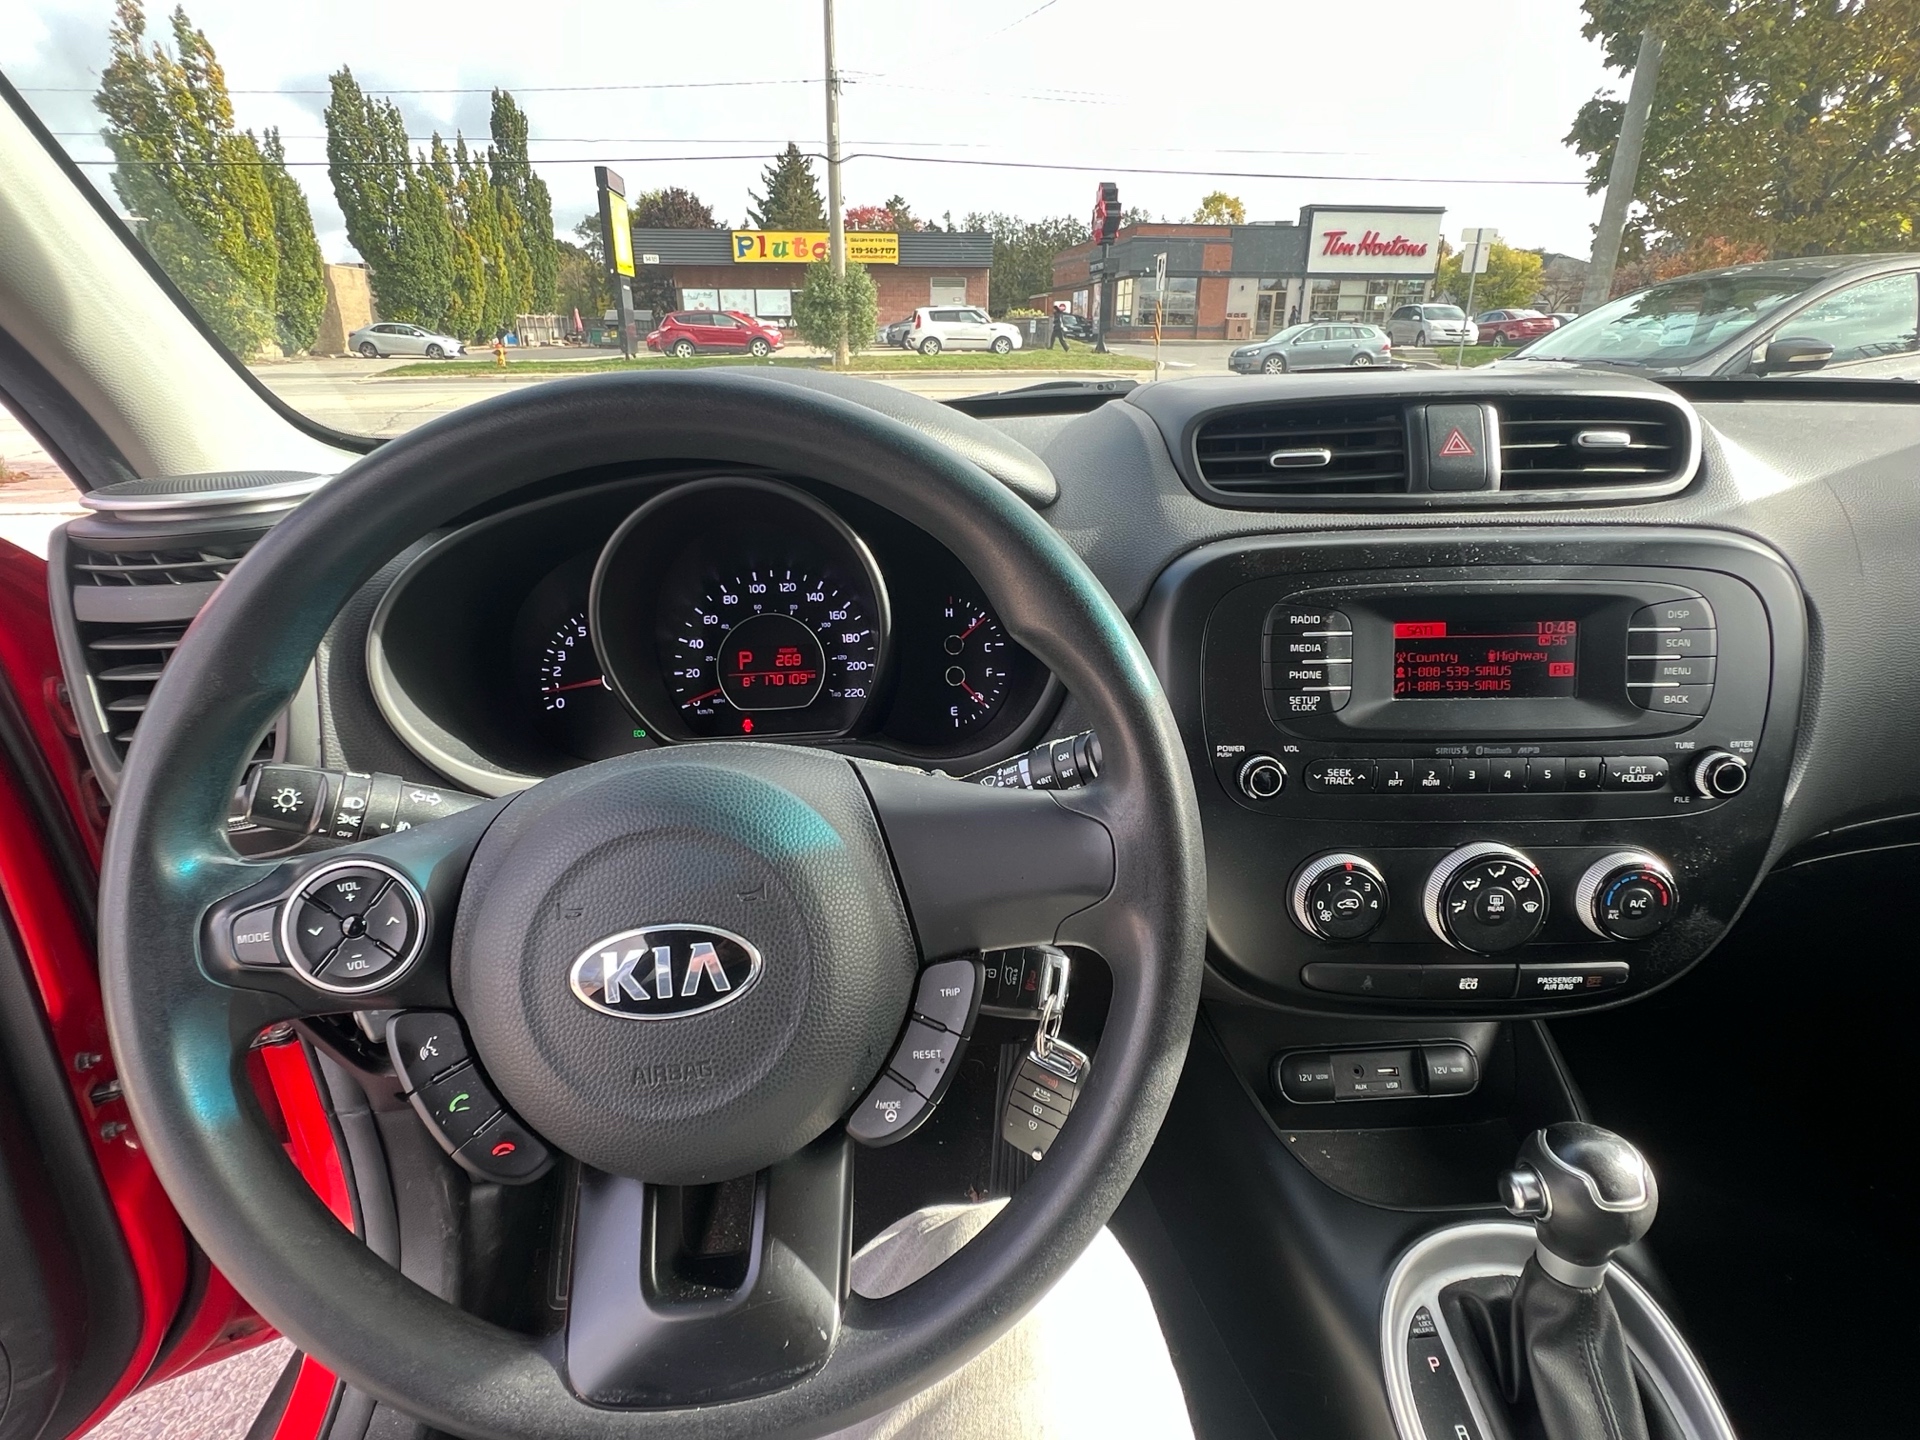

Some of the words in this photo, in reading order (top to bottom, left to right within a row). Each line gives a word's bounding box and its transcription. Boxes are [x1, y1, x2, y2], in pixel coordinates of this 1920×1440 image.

[1323, 231, 1356, 256] Tim
[1357, 230, 1428, 257] Hortons
[748, 584, 767, 593] 100
[779, 583, 797, 593] 120
[723, 595, 739, 605] 80
[806, 592, 825, 602] 140
[829, 610, 847, 620] 160
[945, 608, 953, 618] H
[1667, 610, 1690, 619] DISP
[703, 615, 719, 625] 60
[1290, 615, 1320, 624] RADIO
[578, 626, 587, 637] 5
[1537, 621, 1577, 634] 10:48
[565, 636, 574, 647] 4
[842, 633, 860, 643] 180
[1666, 639, 1691, 647] SCAN
[689, 639, 704, 649] 40
[984, 642, 992, 652] C
[1290, 644, 1321, 652] MEDIA
[557, 651, 566, 662] 3
[738, 651, 753, 670] P
[775, 653, 802, 667] 268
[1408, 653, 1458, 663] Country
[1497, 651, 1548, 662] Highway
[846, 661, 867, 671] 200
[1664, 667, 1691, 675] MENU
[553, 666, 562, 677] 2
[685, 668, 700, 678] 20
[986, 667, 993, 677] F
[1289, 671, 1322, 679] PHONE
[1408, 680, 1511, 691] 1-888-539-SIRIUS
[844, 688, 865, 698] 220
[555, 698, 565, 709] 0
[1289, 696, 1320, 704] SETUP
[1663, 695, 1689, 703] BACK
[950, 706, 958, 716] E
[633, 730, 646, 738] ECO
[1730, 740, 1754, 748] ENTER
[1058, 752, 1069, 761] ON
[1003, 765, 1018, 776] MIST
[1061, 768, 1074, 778] INT
[1327, 769, 1352, 777] SEEK
[1394, 771, 1399, 779] 1
[1468, 770, 1475, 779] 3
[1503, 770, 1511, 779] 4
[1544, 770, 1551, 778] 5
[1578, 769, 1586, 778] 6
[1629, 766, 1647, 774] CAT
[1006, 775, 1018, 785] OFF
[1040, 775, 1052, 785] INT
[1428, 771, 1435, 780] 2
[1622, 774, 1653, 782] FOLDER
[1324, 777, 1354, 785] TRACK
[336, 830, 353, 838] OFF
[1345, 876, 1352, 885] 2
[337, 882, 361, 892] VOL
[1327, 883, 1331, 892] 1
[1364, 883, 1371, 892] 3
[1370, 900, 1378, 909] 4
[1630, 900, 1646, 908] A/C
[236, 932, 271, 944] MODE
[346, 960, 370, 970] VOL
[601, 942, 731, 1004] KIA
[1459, 982, 1478, 990] ECO
[940, 987, 961, 997] TRIP
[913, 1049, 942, 1060] RESET
[1434, 1066, 1447, 1074] 12V
[1299, 1074, 1312, 1082] 12V
[1427, 1356, 1440, 1373] P
